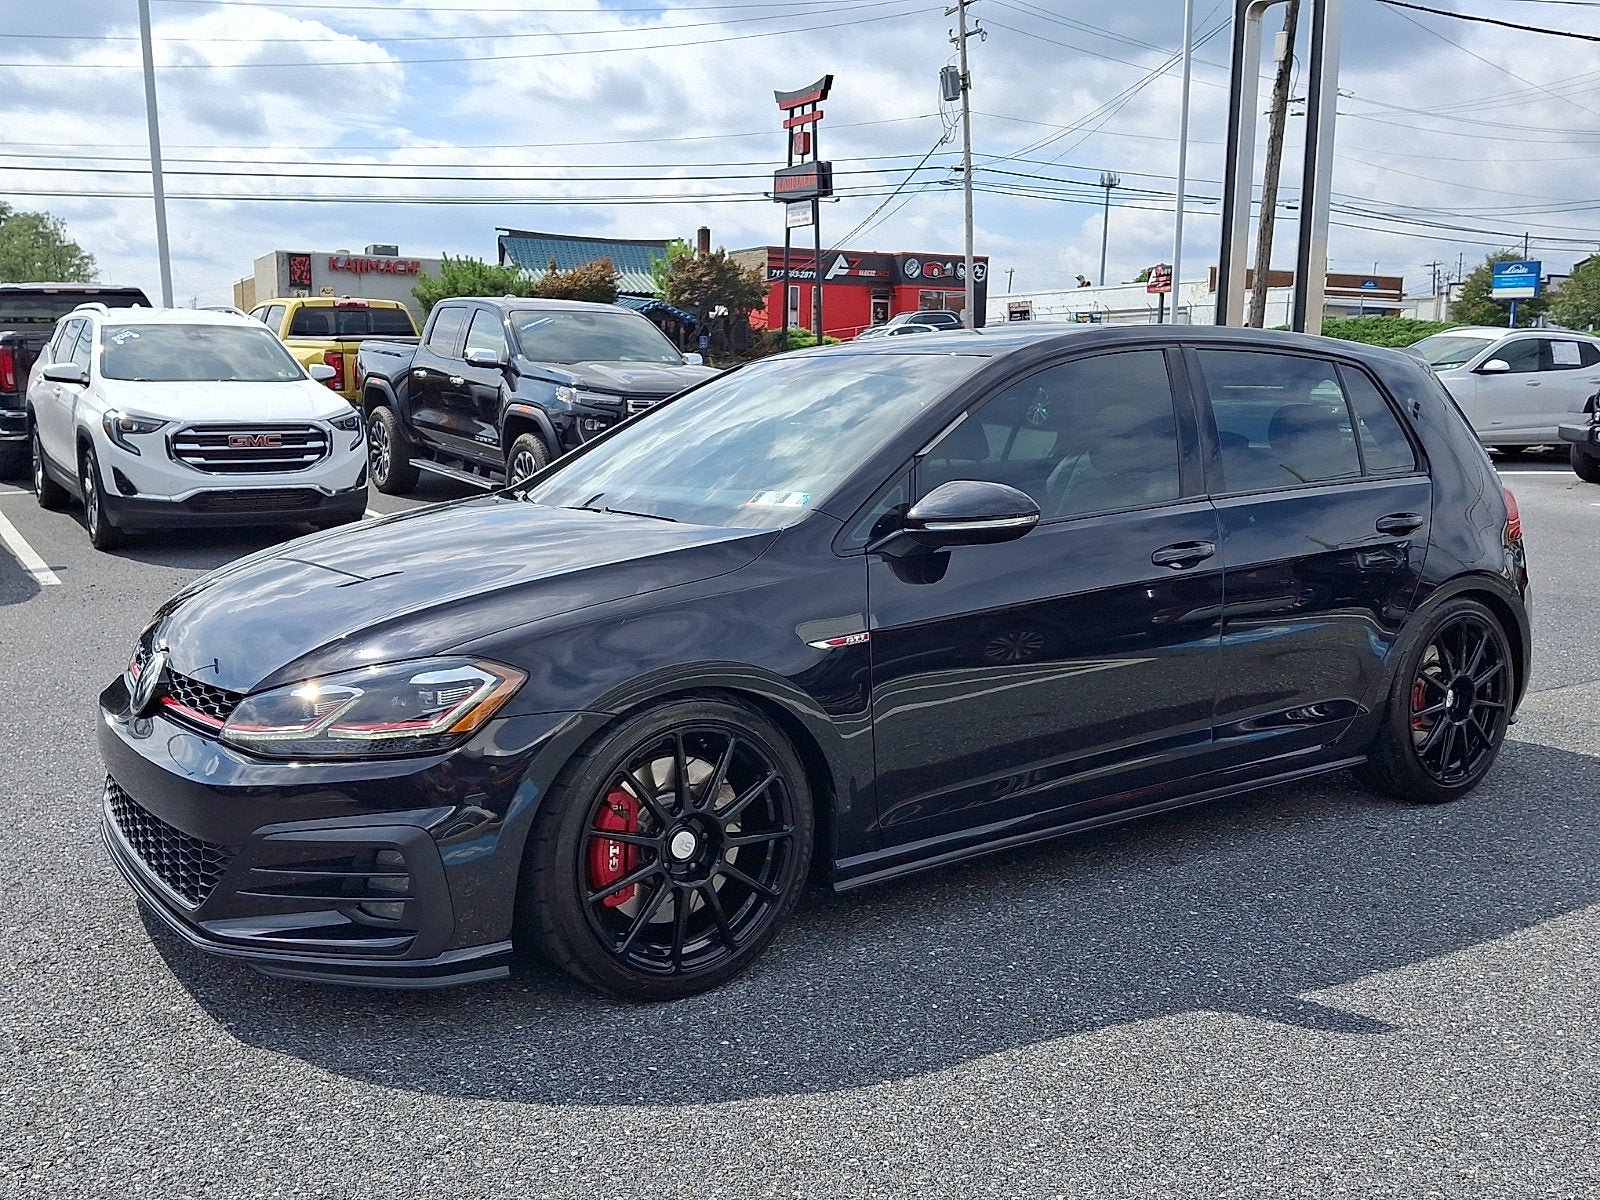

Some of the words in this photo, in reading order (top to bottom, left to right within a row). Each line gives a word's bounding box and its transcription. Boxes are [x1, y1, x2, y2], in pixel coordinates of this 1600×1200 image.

[328, 256, 421, 275] KAJIMACHI
[228, 434, 282, 448] GMC
[608, 839, 620, 872] GT
